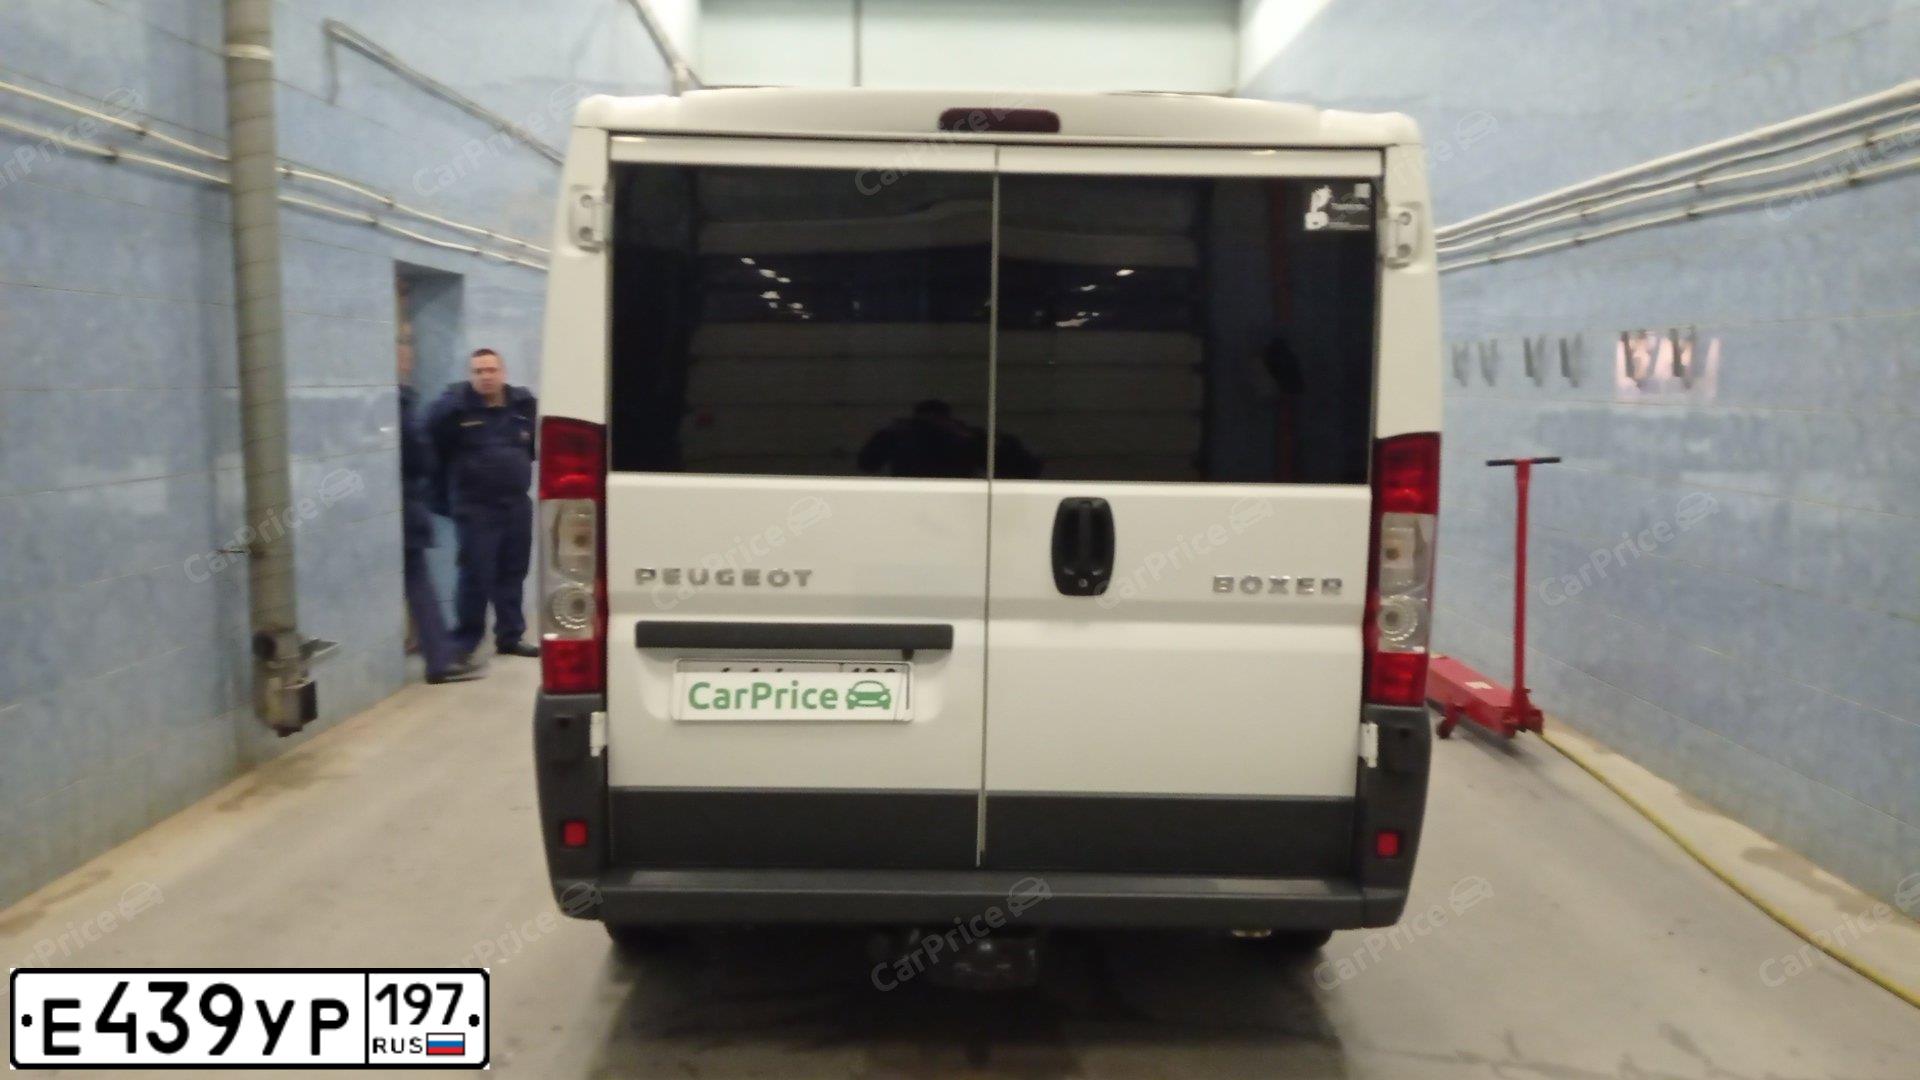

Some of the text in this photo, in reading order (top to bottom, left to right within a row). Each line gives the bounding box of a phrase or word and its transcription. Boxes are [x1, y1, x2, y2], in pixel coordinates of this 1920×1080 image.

[635, 568, 812, 588] PEUGEOT
[1213, 575, 1342, 595] BOXER
[688, 680, 839, 710] CarPrice
